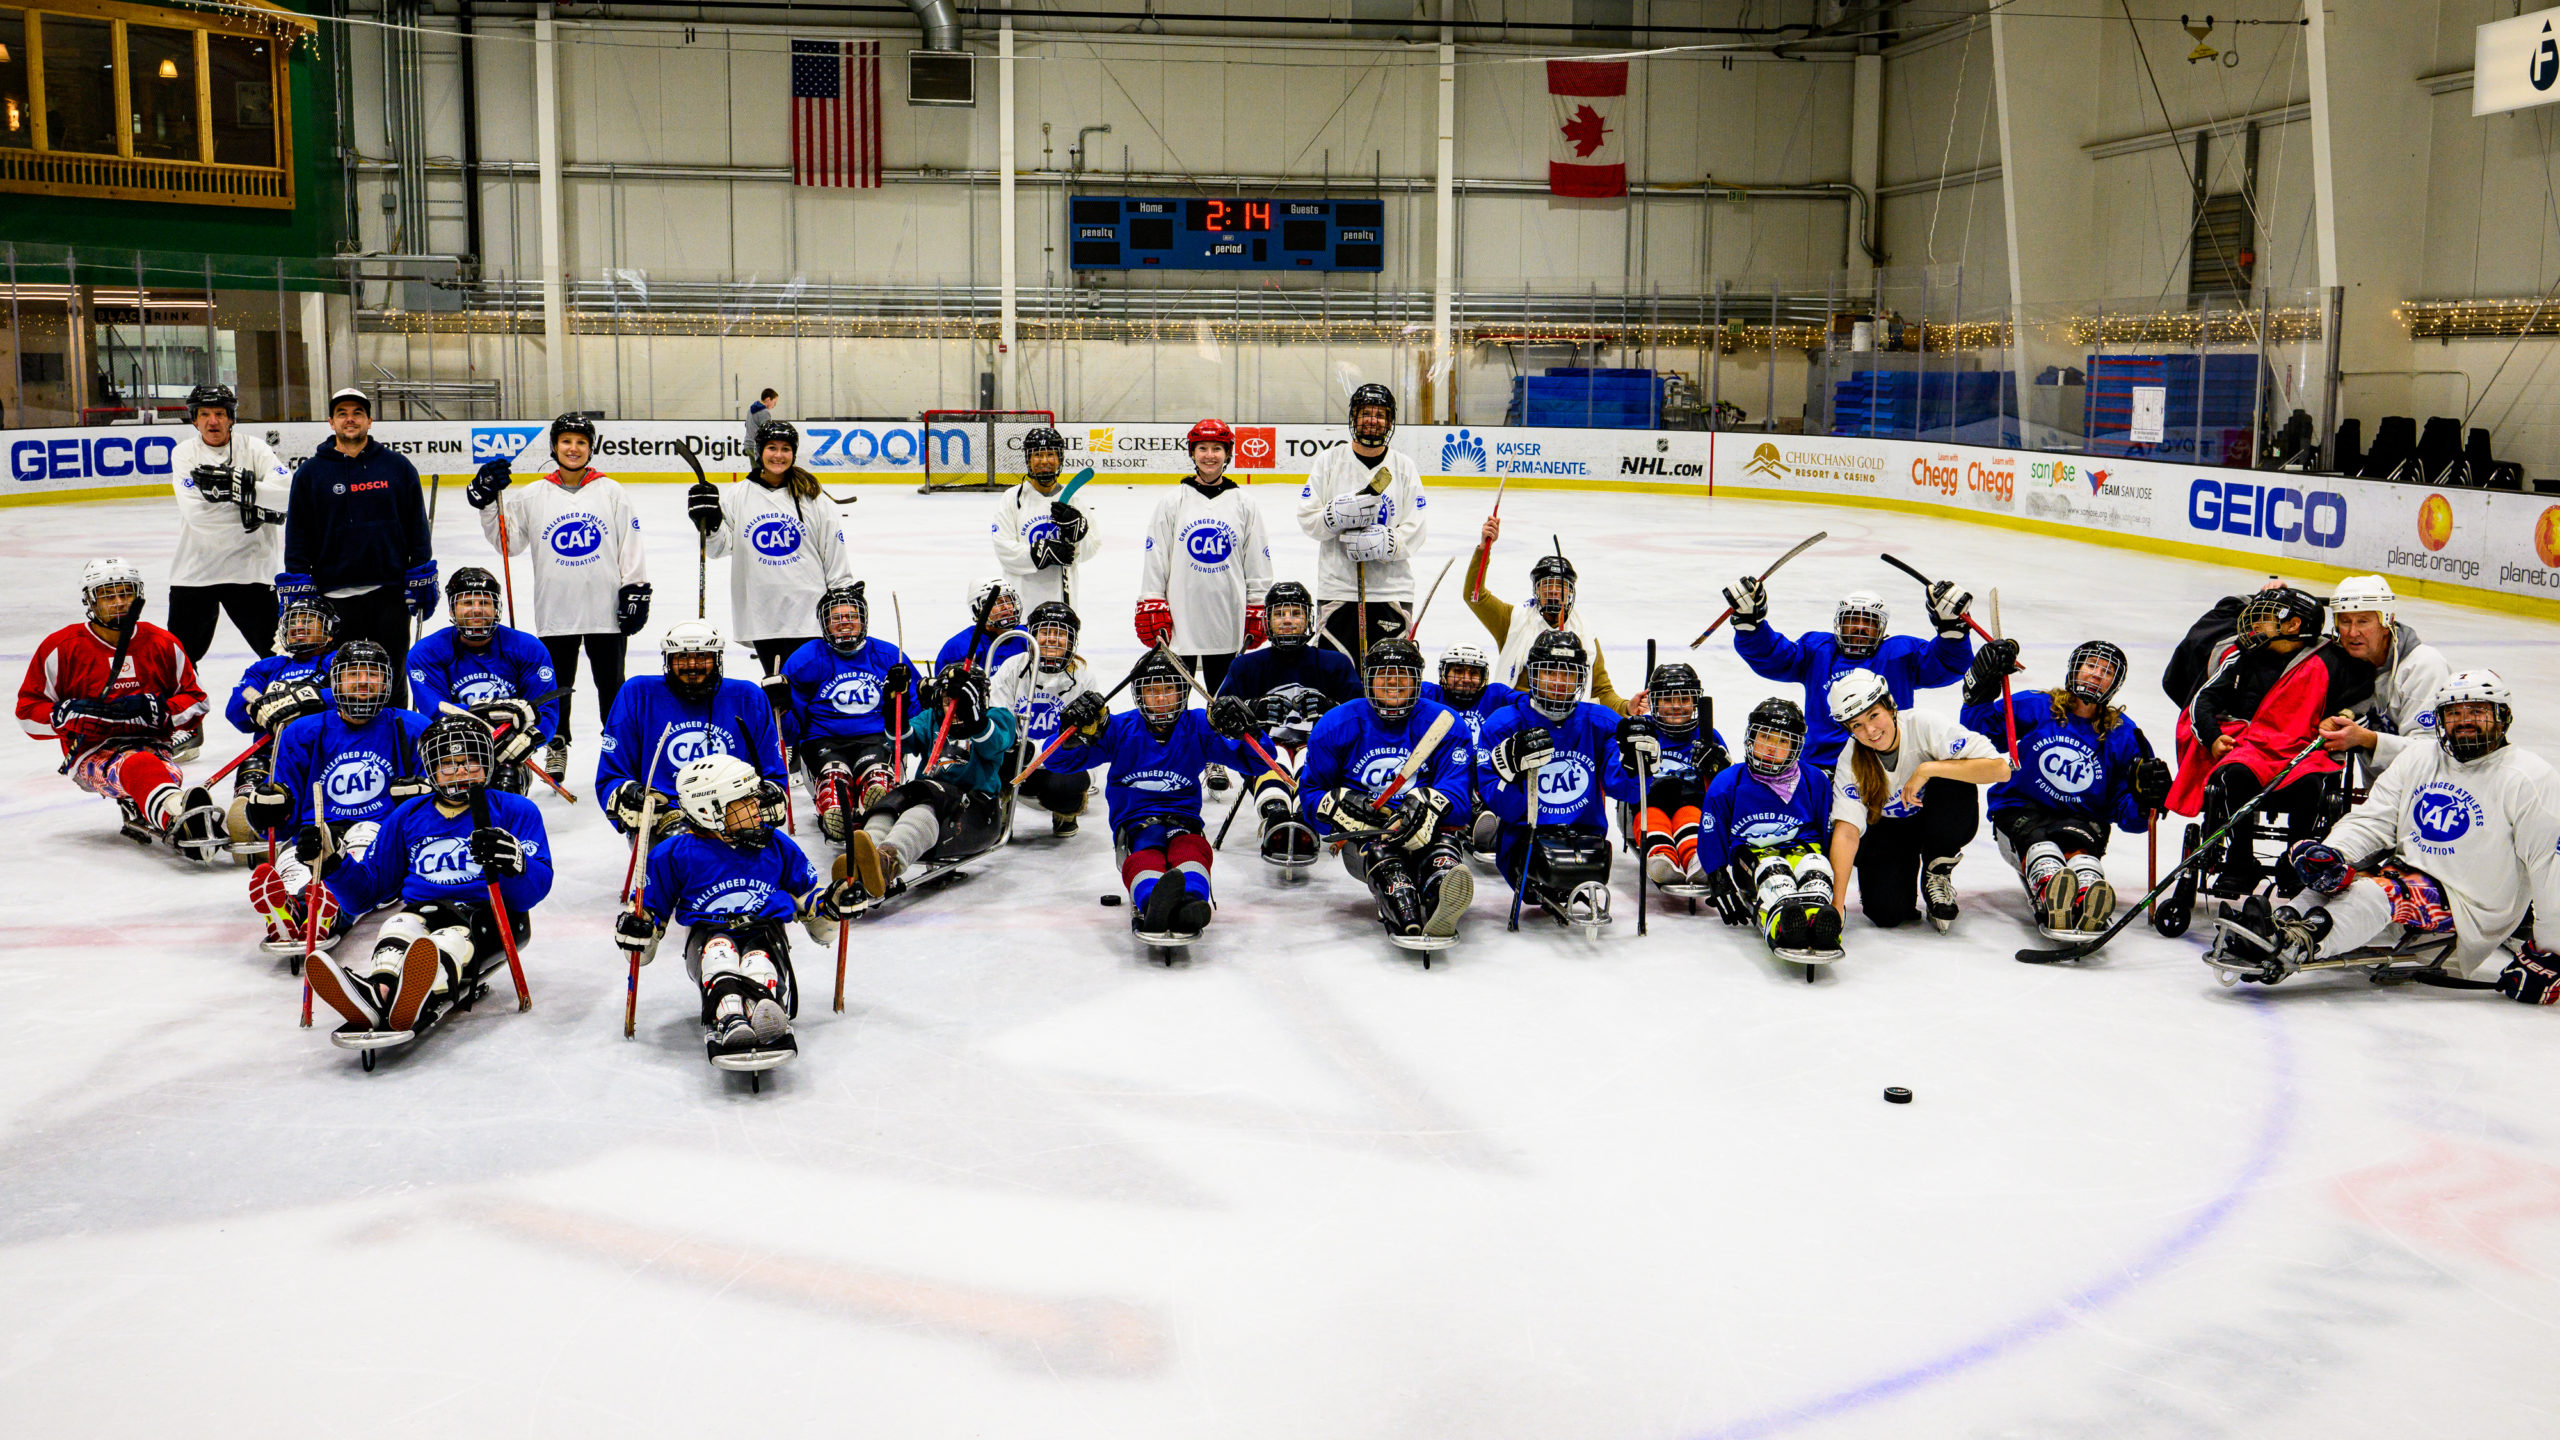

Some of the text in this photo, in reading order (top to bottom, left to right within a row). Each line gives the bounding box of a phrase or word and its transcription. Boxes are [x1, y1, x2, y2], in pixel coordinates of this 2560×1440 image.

[1140, 203, 1163, 213] Home
[1206, 201, 1270, 231] 2:14
[1291, 204, 1319, 214] Guests
[1081, 228, 1113, 238] penalty
[1343, 230, 1374, 241] penalty
[1215, 243, 1242, 255] period
[154, 311, 190, 321] RINK
[427, 440, 462, 453] RUN
[473, 433, 527, 458] SAP
[806, 428, 971, 466] zoom
[1118, 437, 1190, 451] CREEK
[1496, 442, 1541, 455] KAISER
[11, 436, 178, 481] GEICO
[1102, 458, 1147, 468] RESORT
[1496, 460, 1587, 475] PERMANENTE
[1785, 451, 1884, 470] CHUKCHANSI GOLD
[1795, 468, 1875, 483] RESORT & CASINO
[1912, 457, 1958, 496] Chegg
[1967, 461, 2014, 502] Chegg
[350, 481, 388, 492] BOSCH
[2101, 484, 2152, 500] TEAM SAN JOSE
[2188, 478, 2348, 549] GEICO
[541, 512, 580, 540] CHALLENGED
[1179, 519, 1215, 542] CHALLENGED
[554, 529, 596, 550] CAF
[755, 530, 796, 549] CAF
[1190, 535, 1230, 556] CAF
[555, 553, 601, 567] FOUNDATION
[1190, 562, 1230, 574] FOUNDATION
[2387, 546, 2480, 580] planet orange
[2499, 560, 2548, 588] planet
[278, 584, 317, 594] BAUER
[627, 593, 650, 601] CC
[1352, 747, 1397, 774] CHALLENGED
[2043, 752, 2092, 784] CAF
[331, 769, 379, 796] CAF
[1537, 768, 1582, 794] CAF
[691, 788, 717, 799] BAUER
[330, 800, 384, 816] FOUNDATION
[1538, 796, 1589, 815] FOUNDATION
[2455, 787, 2485, 828] ATHLETES
